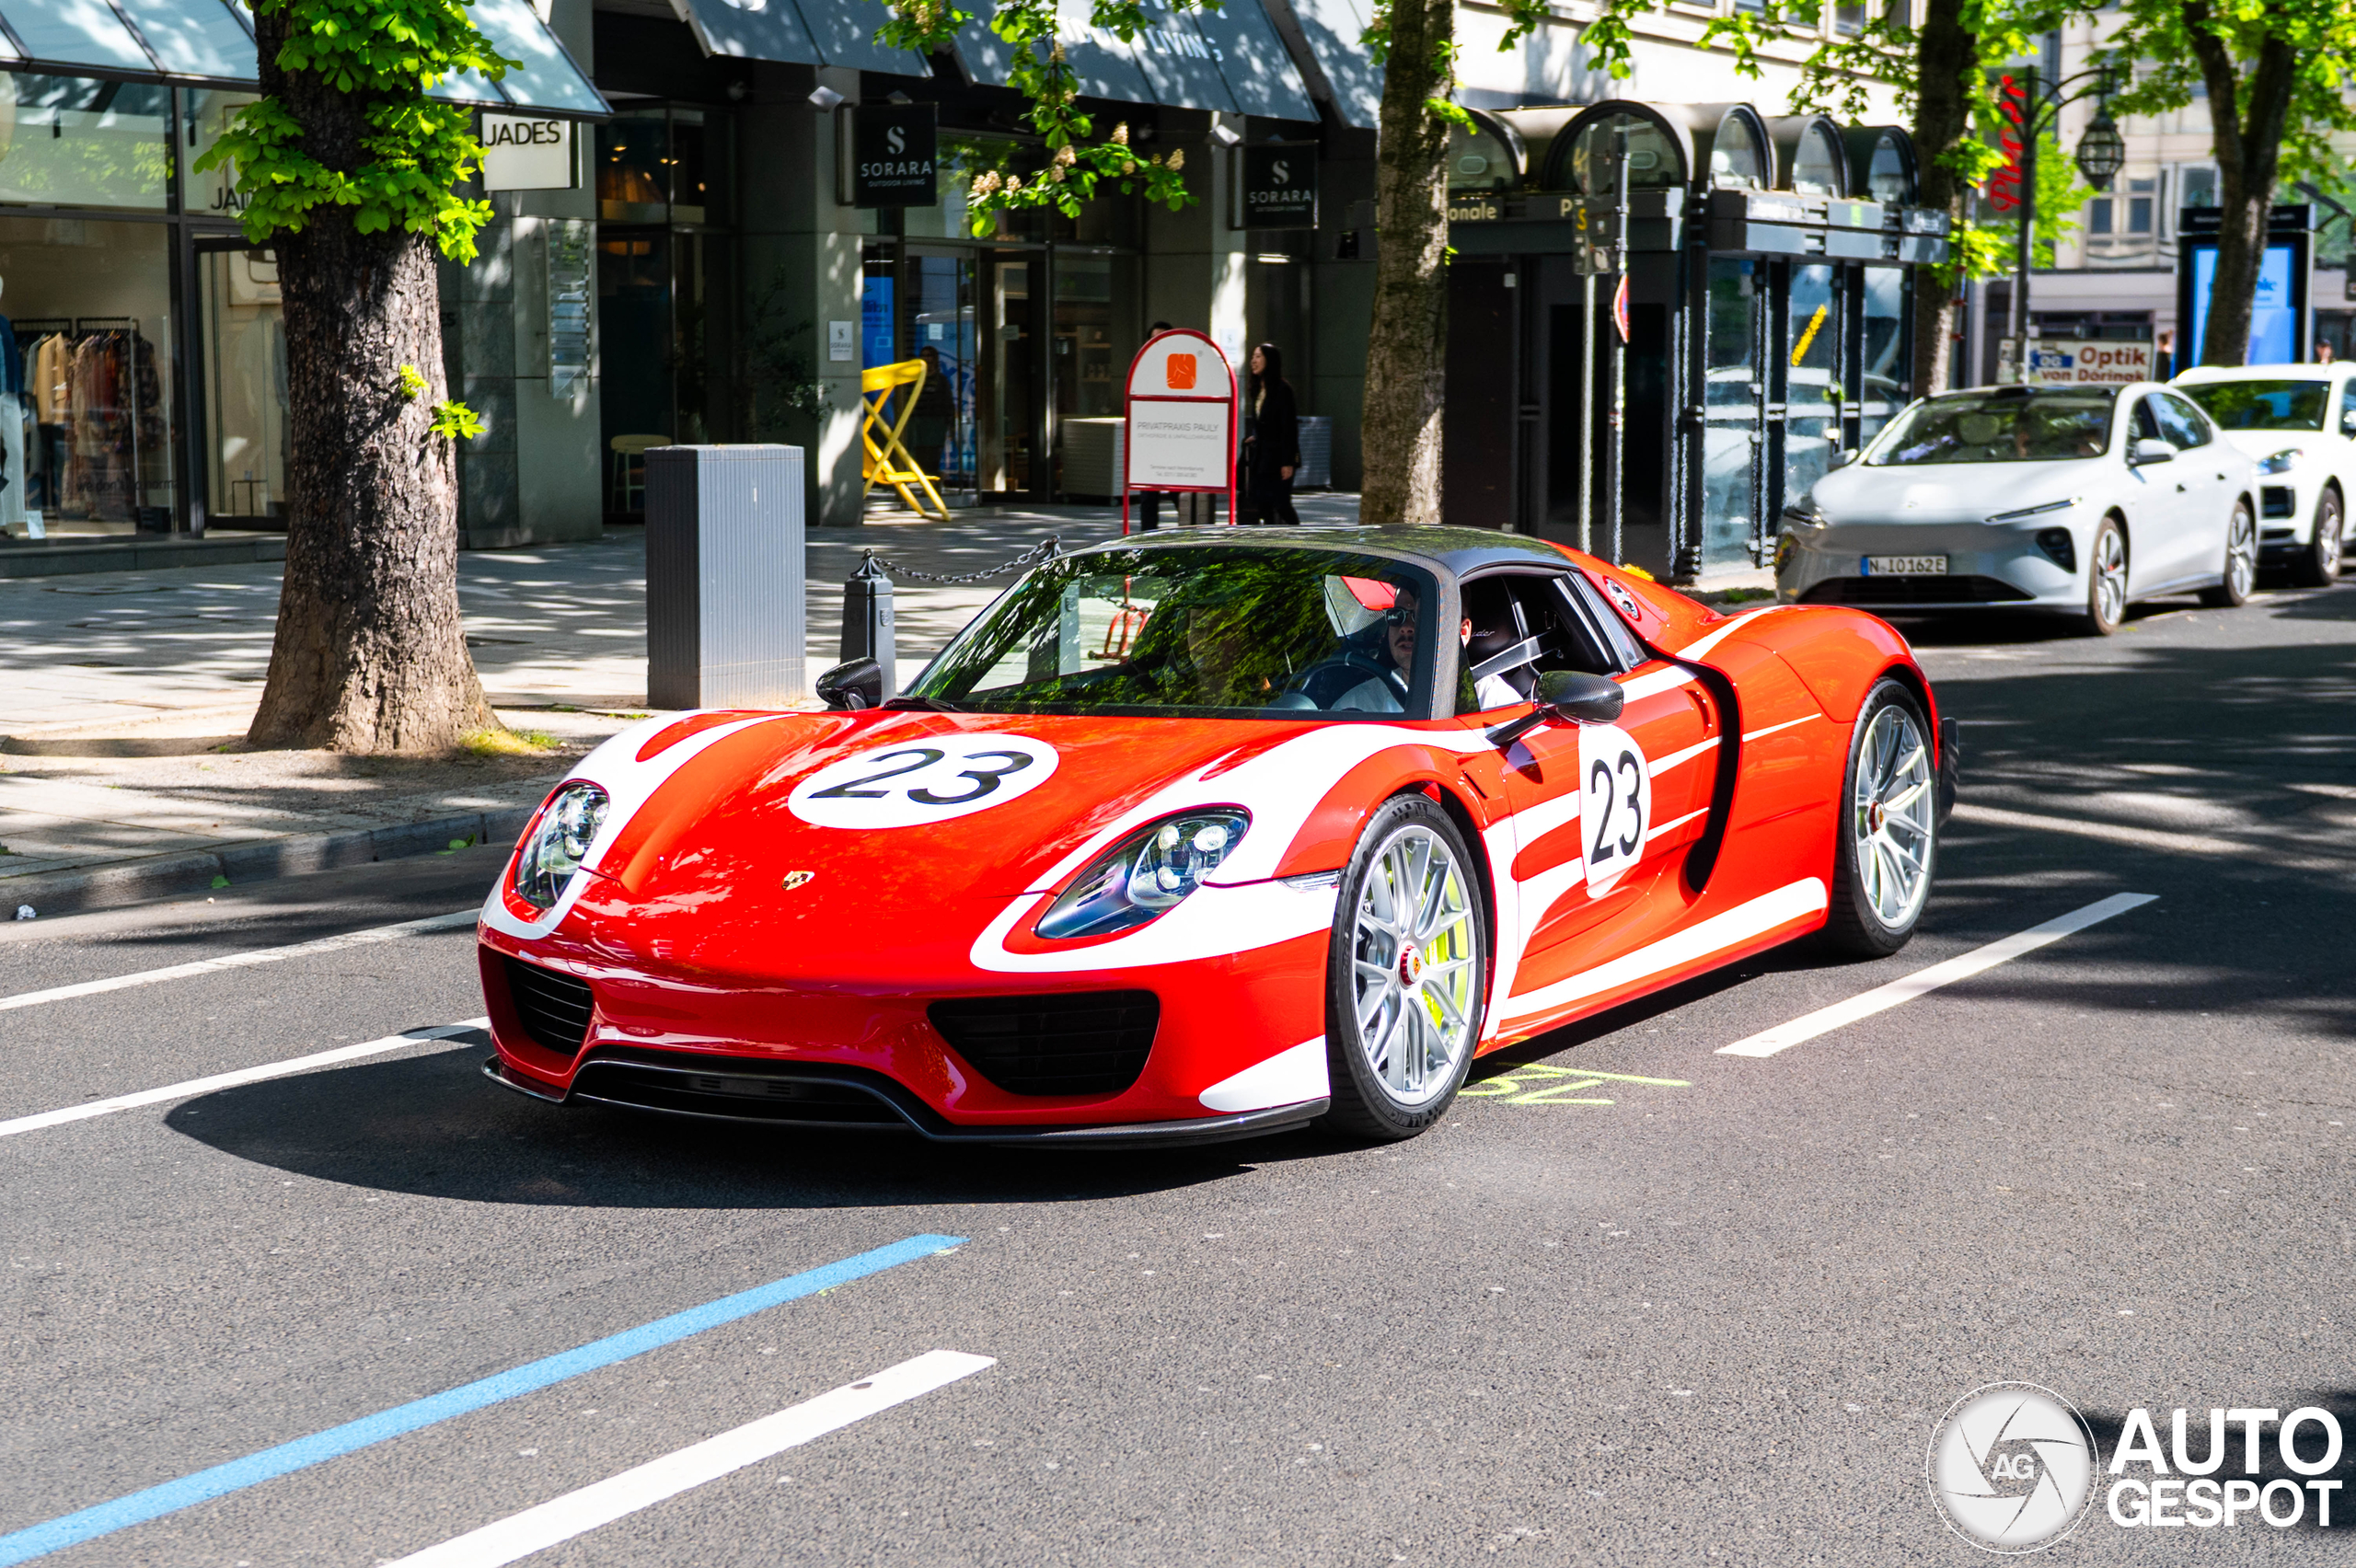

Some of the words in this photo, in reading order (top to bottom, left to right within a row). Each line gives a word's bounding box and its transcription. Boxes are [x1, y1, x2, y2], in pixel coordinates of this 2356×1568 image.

[485, 121, 561, 146] JADES
[860, 160, 932, 178] SORARA
[1249, 190, 1312, 203] SORARA
[1448, 202, 1498, 221] onale
[2080, 346, 2147, 369] Optik
[1138, 421, 1191, 432] PRIVATPRAXIS
[1194, 423, 1219, 432] PAULY
[807, 747, 1034, 805] 23
[1590, 749, 1642, 865] 23
